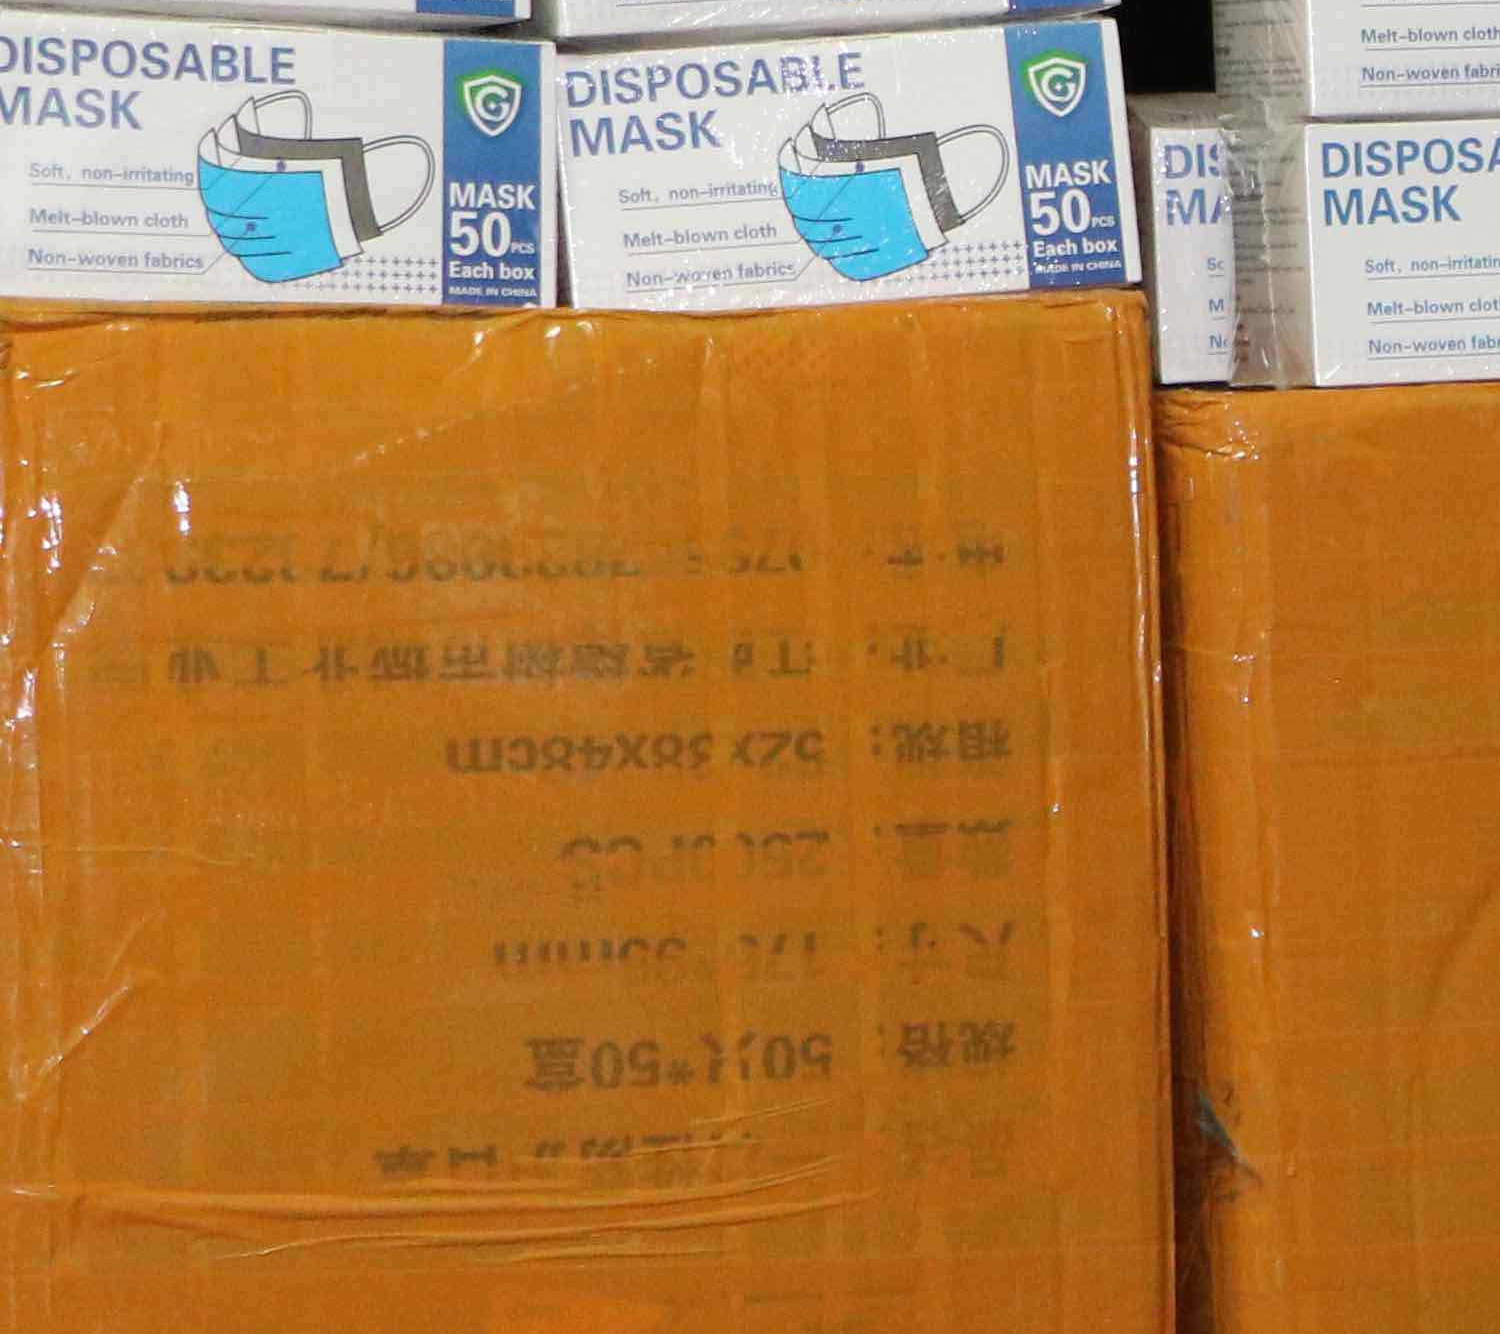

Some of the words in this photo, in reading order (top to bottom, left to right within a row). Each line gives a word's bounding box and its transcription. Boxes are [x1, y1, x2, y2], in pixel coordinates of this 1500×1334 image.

[1360, 27, 1457, 44] Melt-blown
[564, 51, 865, 108] DISPOSABLE
[1362, 66, 1459, 83] Non-woven
[569, 109, 720, 158] MASK
[1024, 159, 1111, 190] MASK
[449, 181, 535, 211] MASK
[1324, 184, 1460, 226] MASK
[29, 209, 138, 228] Melt-blown
[144, 213, 188, 229] cloth
[1028, 188, 1092, 237] 50
[449, 209, 510, 258] 50
[1032, 238, 1078, 258] Each
[1081, 235, 1118, 255] box
[28, 250, 137, 268] Non-woven
[145, 253, 204, 269] fabrics
[448, 260, 494, 279] Each
[498, 262, 534, 281] box
